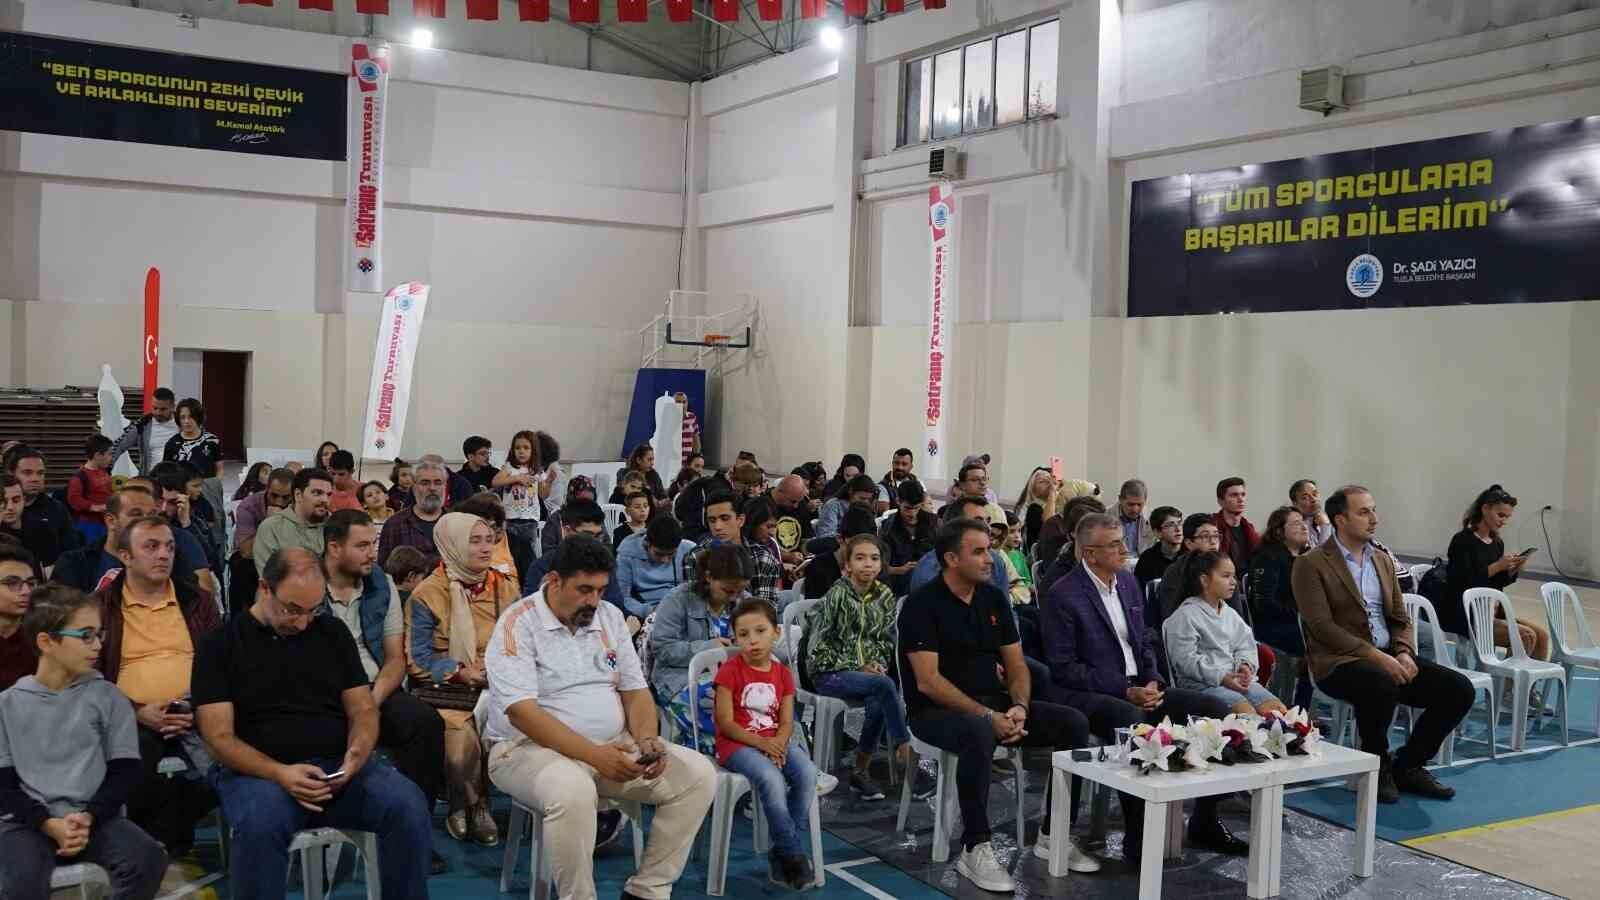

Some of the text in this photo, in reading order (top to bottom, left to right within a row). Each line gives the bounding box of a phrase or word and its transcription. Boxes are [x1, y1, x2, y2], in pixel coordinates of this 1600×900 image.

[42, 61, 304, 104] "BEN SPORCUNUN ZEKİ ÇEVİK
[56, 81, 81, 96] VE
[85, 85, 200, 109] AHLAKLISINI
[360, 96, 373, 183] Turnuvası
[1276, 159, 1493, 207] SPORCULARA
[356, 184, 379, 241] Satranç
[1184, 215, 1339, 253] BAŞARILAR
[1393, 262, 1409, 274] Dr.
[1439, 258, 1477, 272] YAZICI
[930, 246, 943, 350] Turnuvası
[927, 351, 944, 418] Satranç
